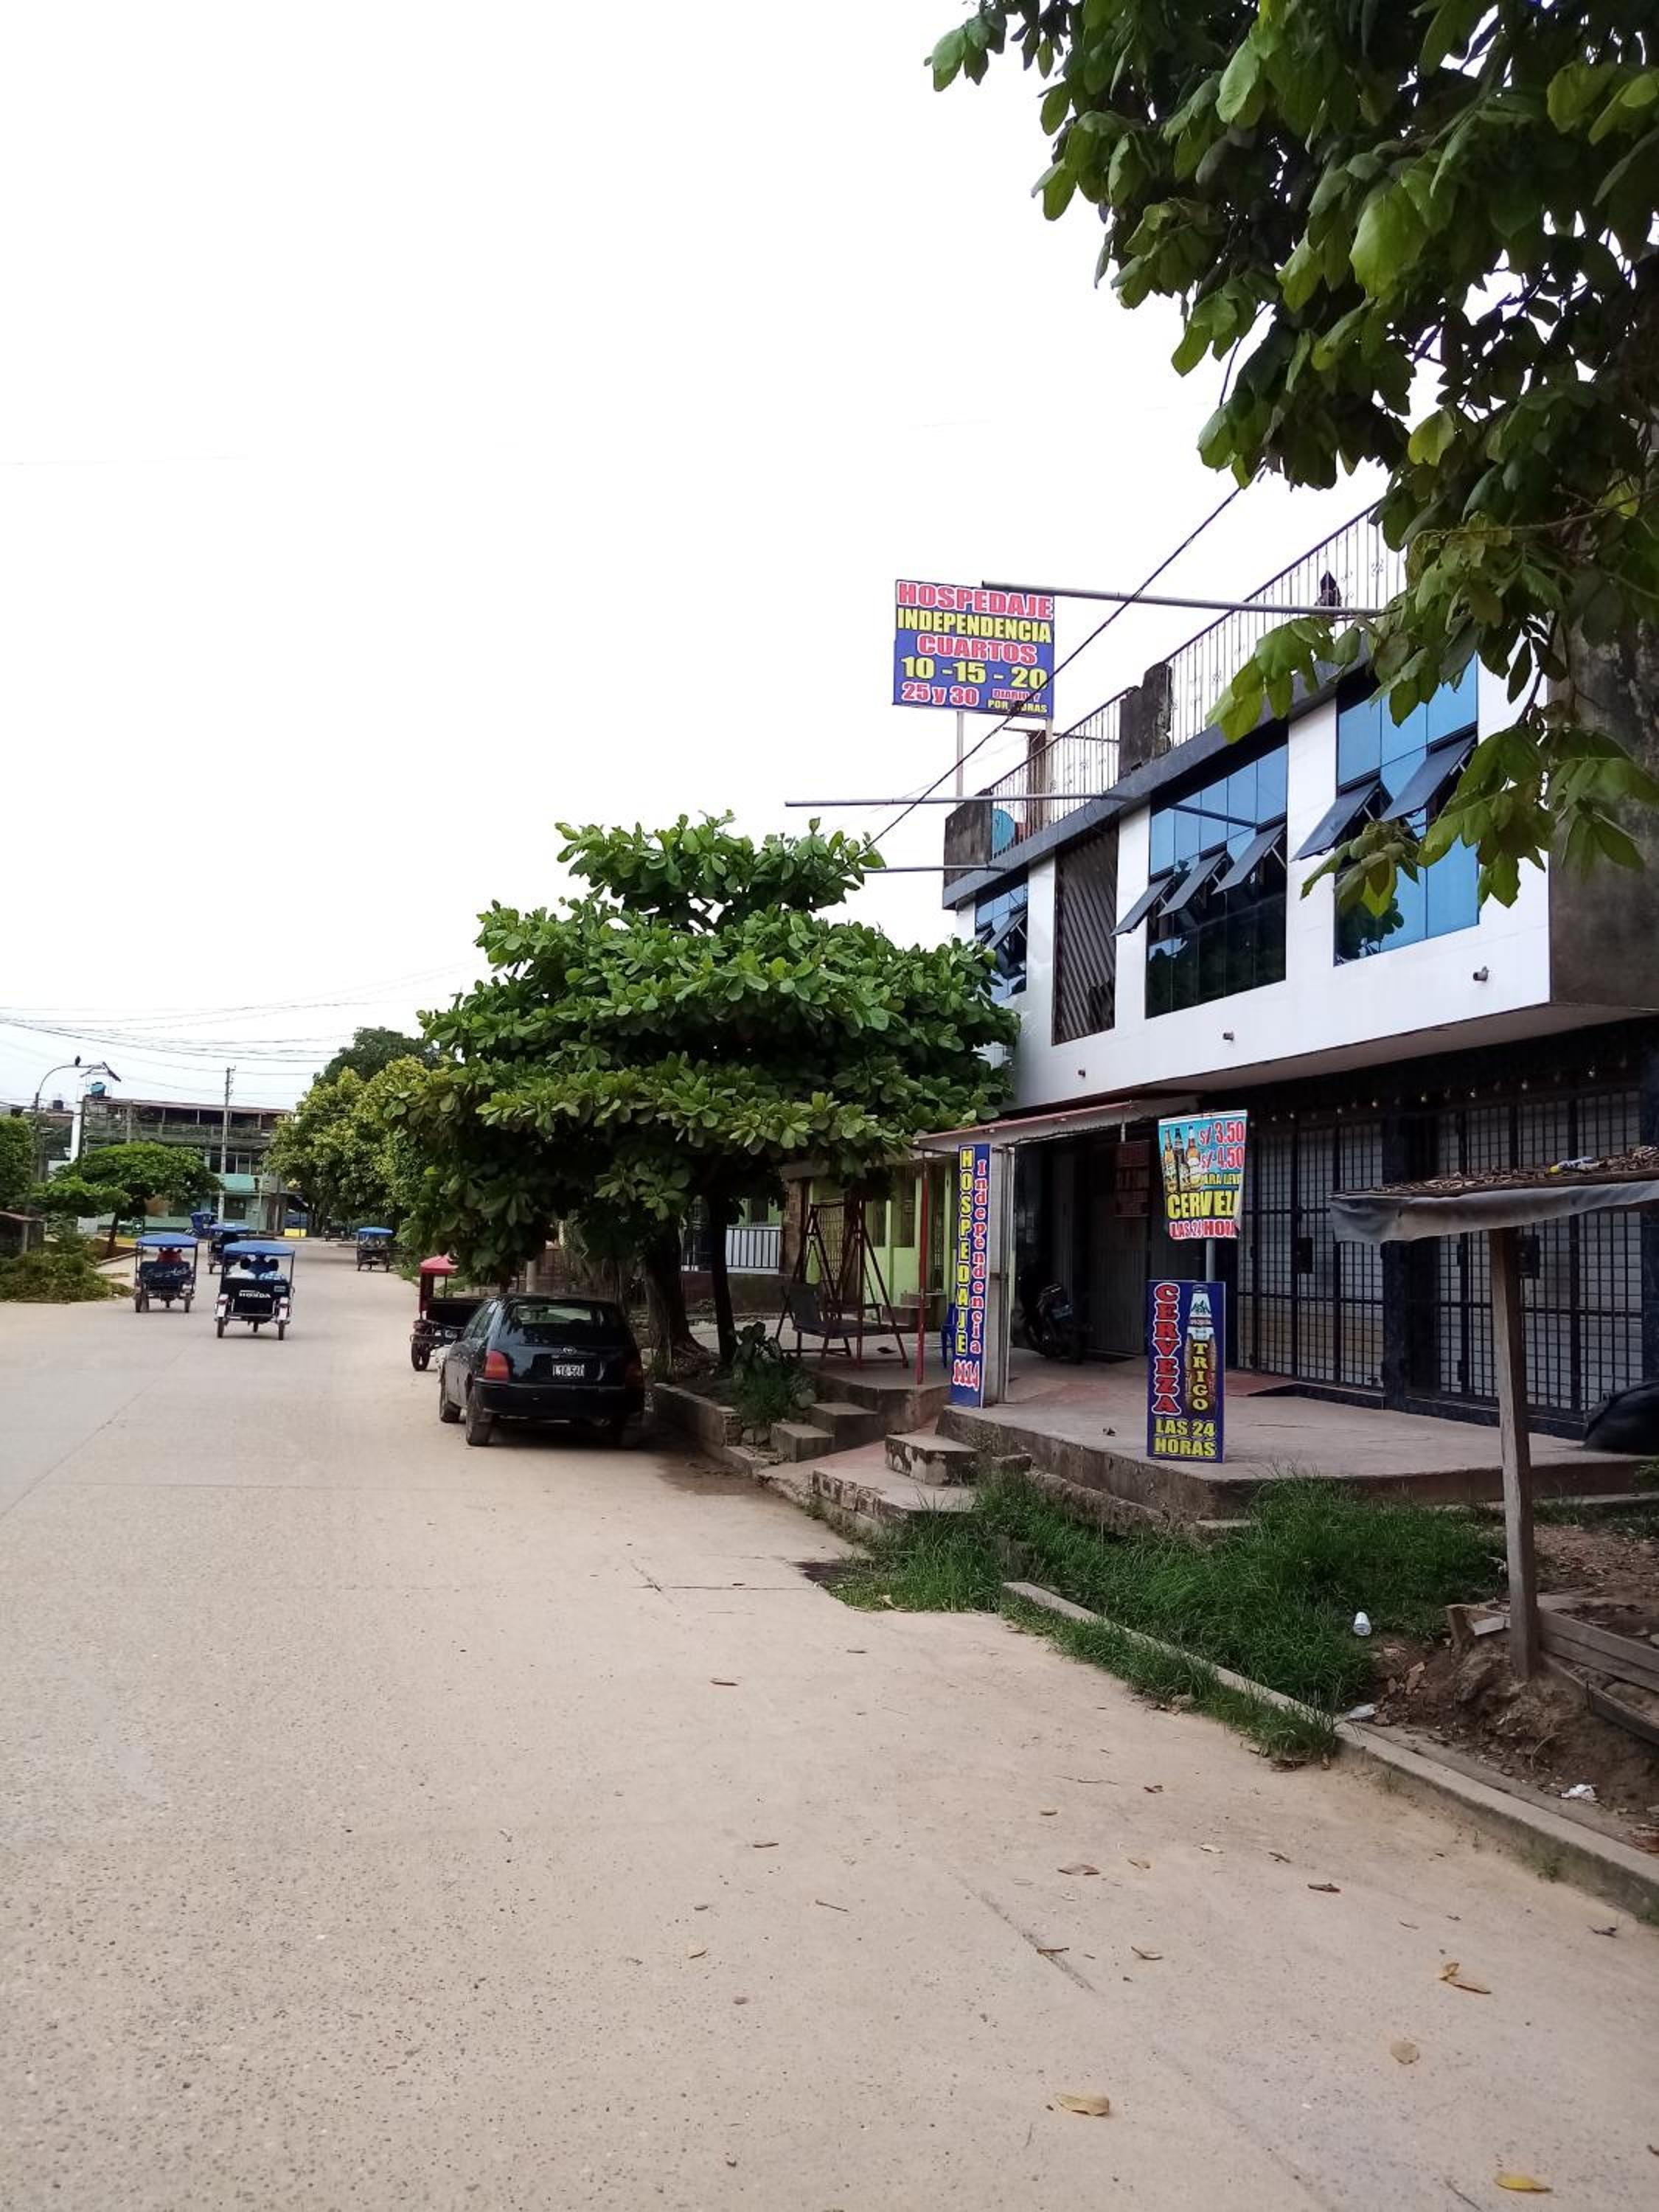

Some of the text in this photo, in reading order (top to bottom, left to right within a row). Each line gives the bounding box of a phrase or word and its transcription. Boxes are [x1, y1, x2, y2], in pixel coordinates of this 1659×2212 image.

[897, 581, 1053, 620] HOSPEDAJE
[897, 608, 1051, 643] INDEPENDENCIA
[917, 634, 1037, 665] CUARTOS
[902, 656, 934, 679] 10
[1011, 667, 1048, 689] 20
[902, 682, 930, 701] 25
[950, 685, 979, 706] 30
[987, 699, 1048, 713] POR RAS
[1214, 1120, 1245, 1144] 3.50
[1217, 1146, 1244, 1169] 4.50
[956, 1146, 975, 1355] HOSPEDAJE
[970, 1159, 987, 1354] Independencia
[1152, 1282, 1181, 1415] CERVEZA
[1192, 1342, 1209, 1411] TRIGO
[1155, 1417, 1215, 1437] LAS 24
[1153, 1437, 1216, 1457] HORAS
